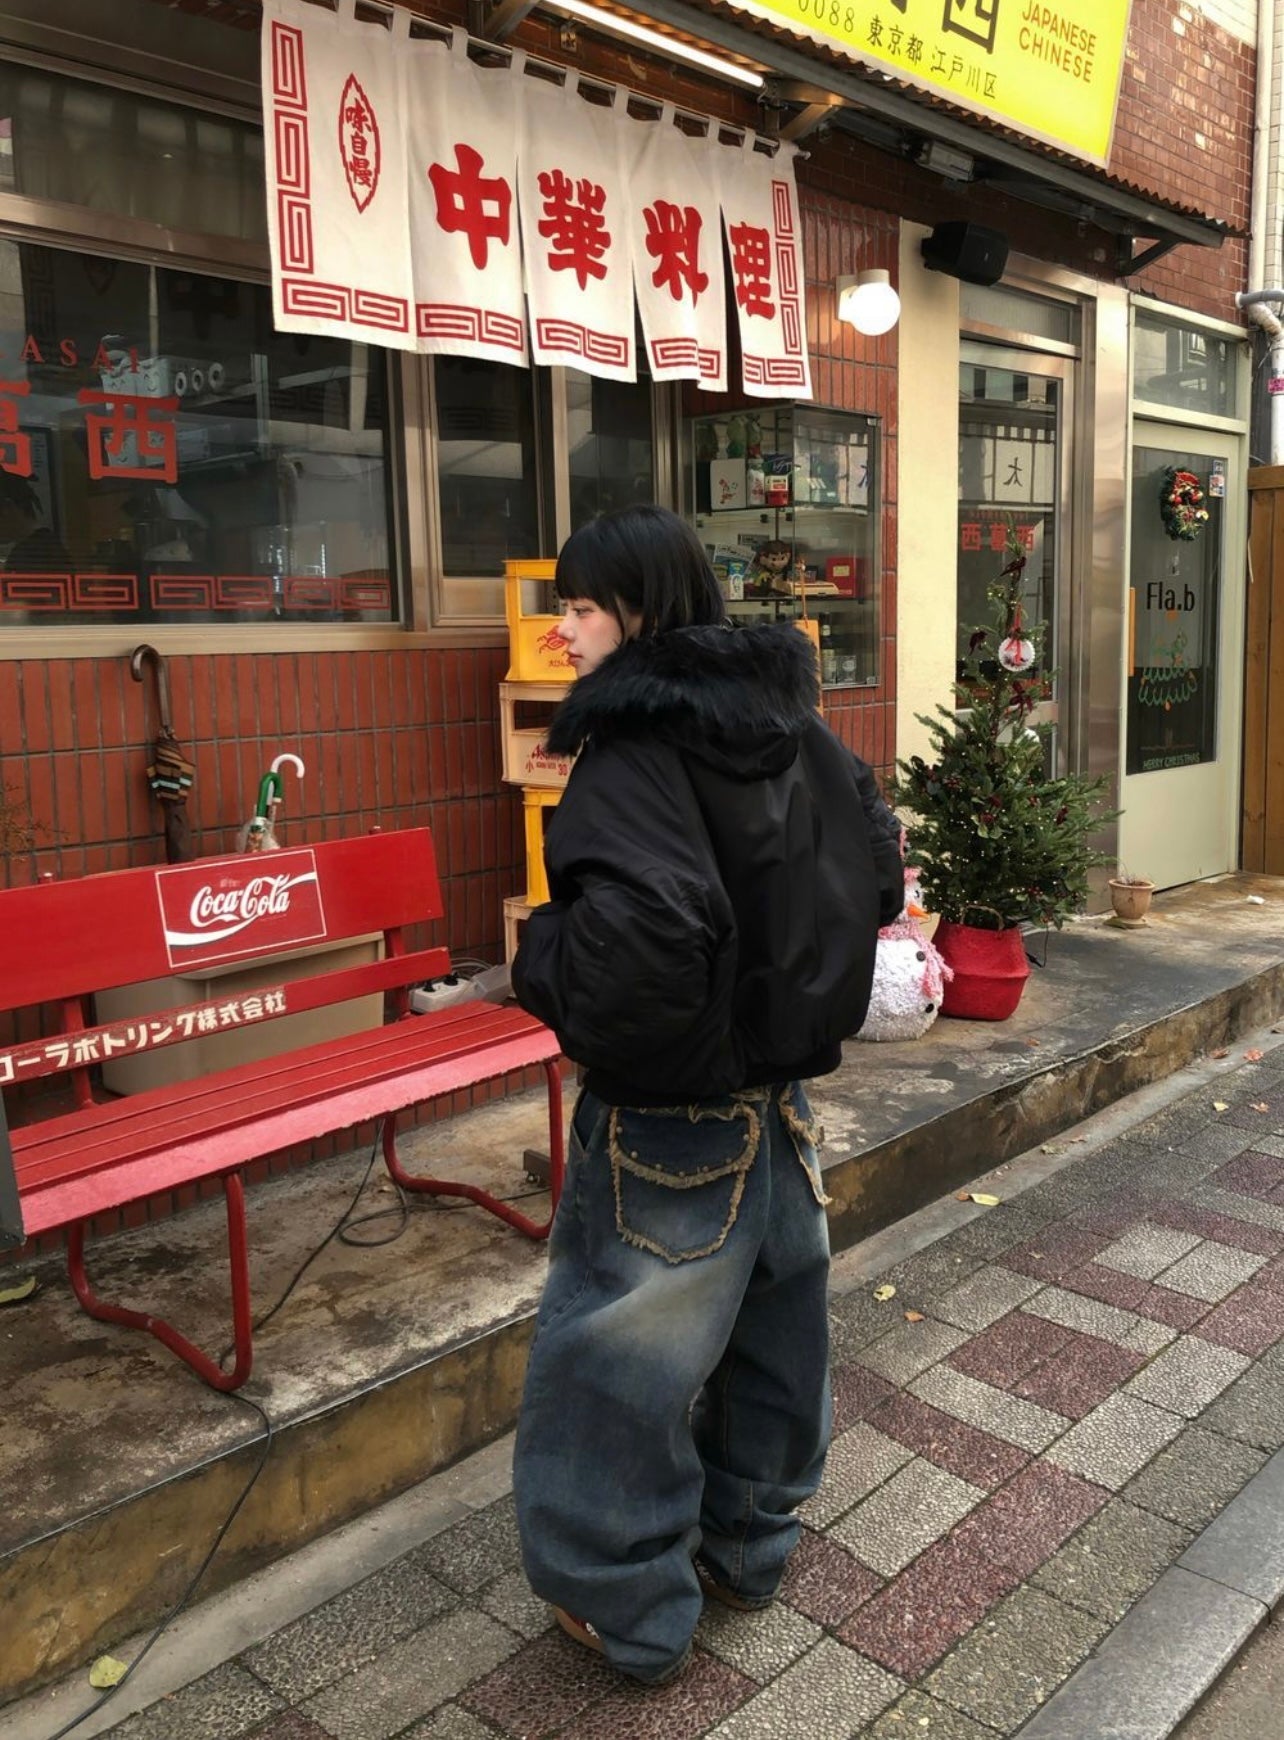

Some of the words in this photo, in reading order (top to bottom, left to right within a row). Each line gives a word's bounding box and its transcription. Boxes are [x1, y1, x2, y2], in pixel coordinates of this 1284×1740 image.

[866, 14, 923, 64] 東京都
[930, 46, 997, 98] 江戸川区
[1019, 27, 1093, 83] CHINESE
[1022, 0, 1097, 56] JAPANESE
[345, 97, 372, 188] 味自慢
[428, 143, 775, 320] 中華料理
[1147, 581, 1195, 612] Fla.b
[190, 873, 291, 928] Coca-Cola
